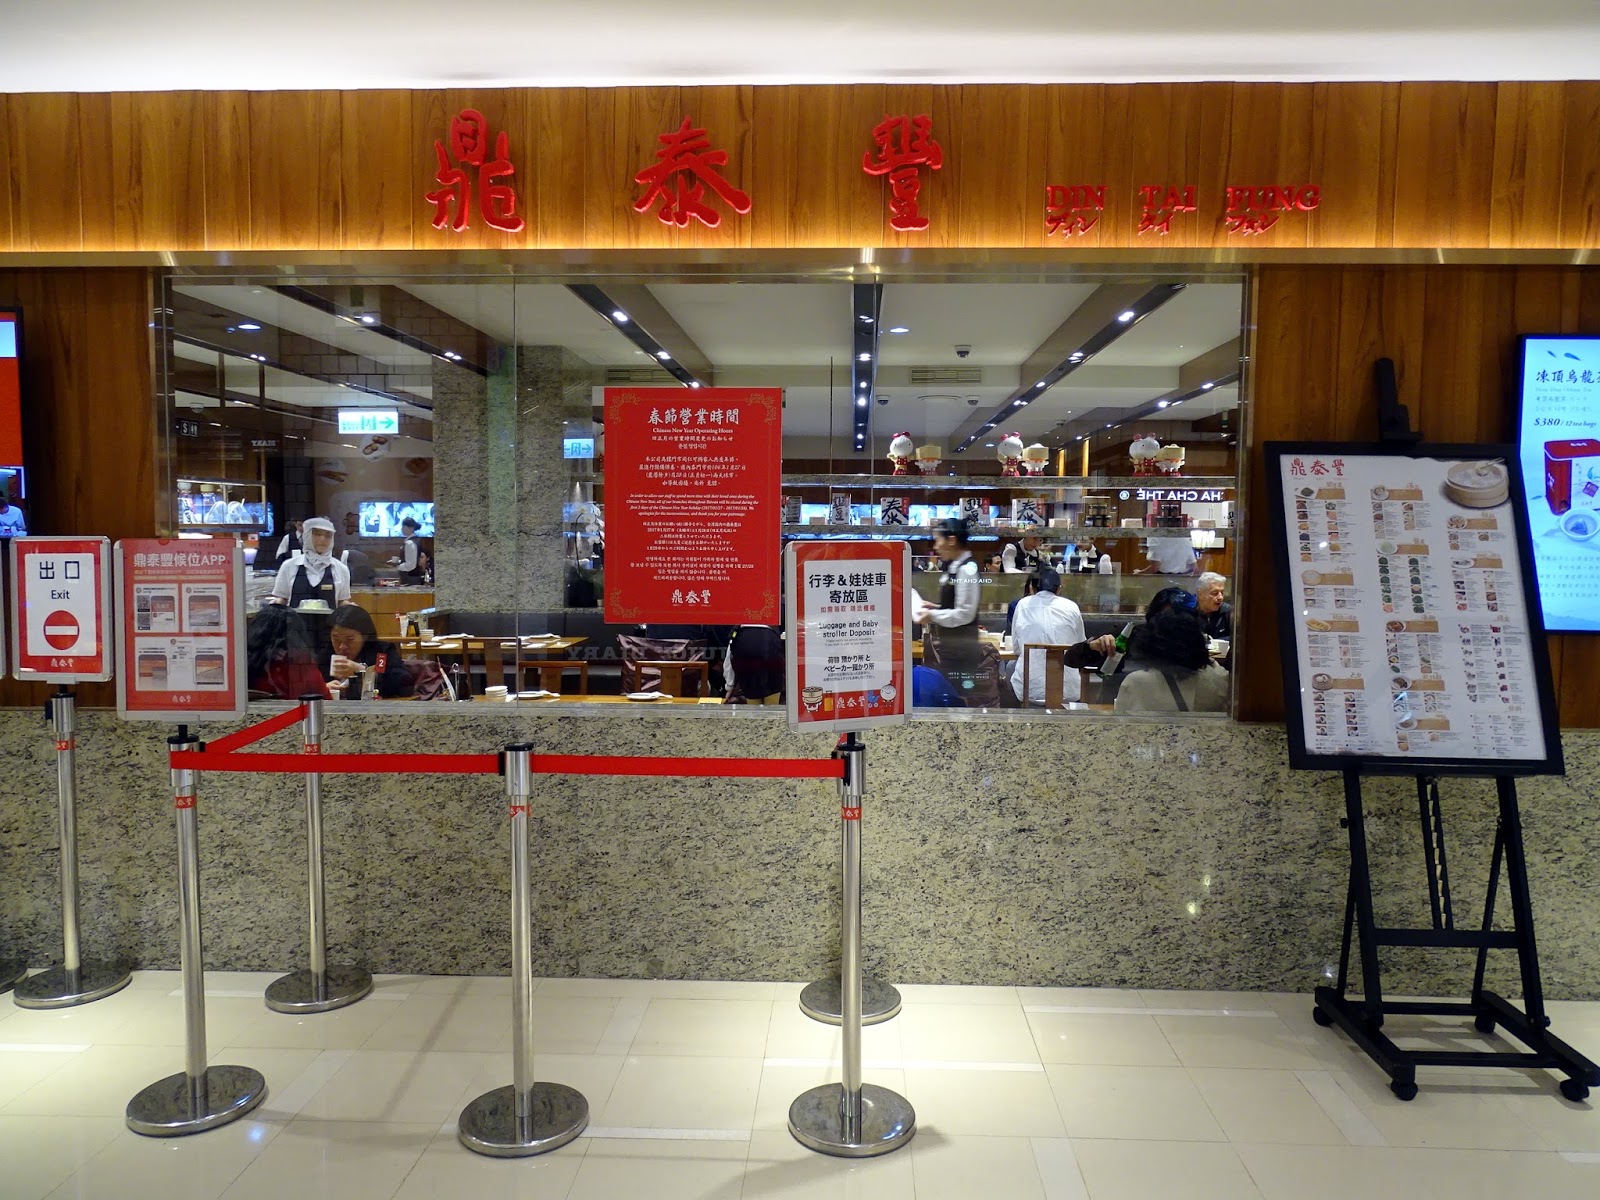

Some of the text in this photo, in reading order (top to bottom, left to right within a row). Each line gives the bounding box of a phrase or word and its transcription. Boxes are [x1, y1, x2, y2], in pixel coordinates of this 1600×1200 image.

[424, 108, 944, 234] 鼎泰豐
[1046, 184, 1322, 212] DIN TAI FUNG
[1045, 213, 1099, 238] ディン
[1137, 213, 1176, 237] タイ
[647, 407, 740, 426] 春節營業時間
[1290, 458, 1345, 476] 鼎泰豐
[134, 552, 226, 567] 鼎泰豐候位APP
[40, 560, 80, 580] 出口
[809, 574, 835, 588] 行李
[849, 573, 887, 587] 娃娃車
[51, 590, 70, 600] Exit
[672, 588, 712, 604] 鼎泰豐
[829, 590, 868, 604] 寄放區
[862, 620, 878, 628] Baby
[379, 659, 384, 668] 2
